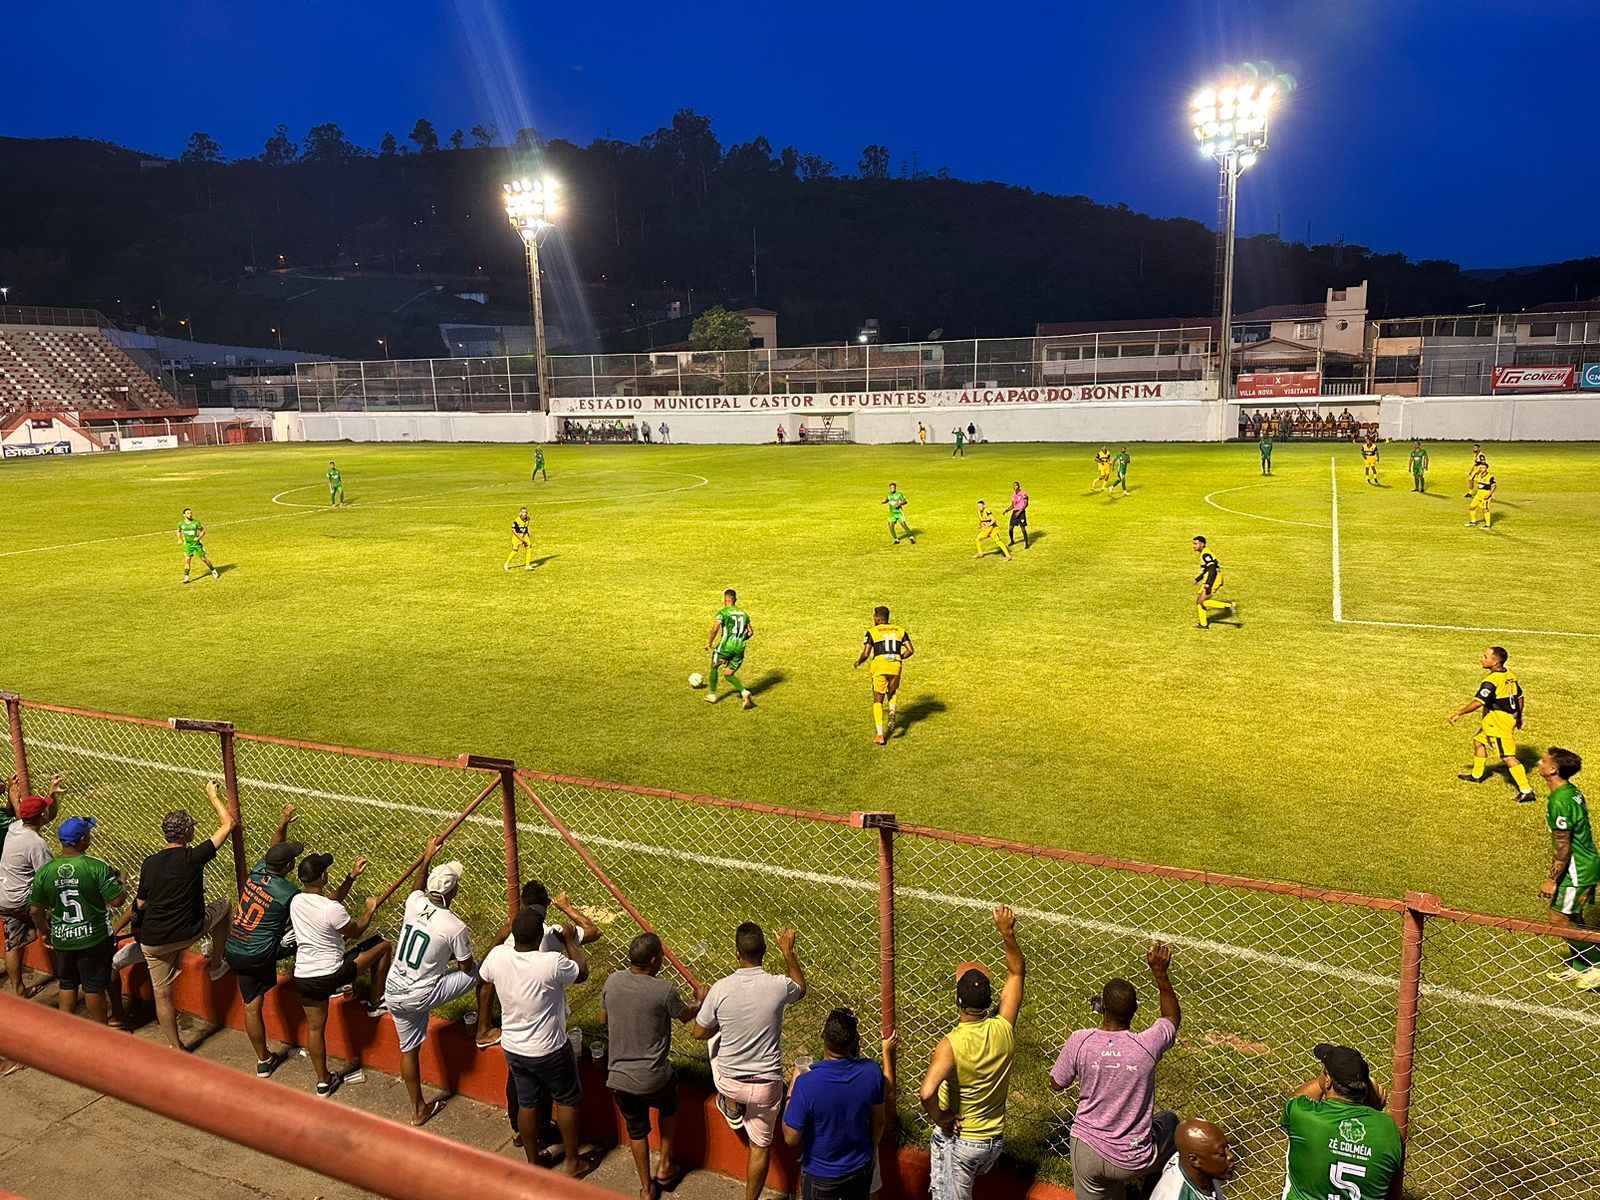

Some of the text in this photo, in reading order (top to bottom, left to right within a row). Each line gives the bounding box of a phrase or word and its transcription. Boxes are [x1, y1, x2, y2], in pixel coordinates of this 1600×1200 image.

[1523, 372, 1565, 381] CONEM
[1047, 388, 1073, 401] DO
[1081, 383, 1162, 401] BONFIM
[1284, 387, 1317, 395] VISITANTE
[579, 392, 927, 410] ESTÁDIO MUNICIPAL CASTOR CIFUENTES
[883, 633, 897, 652] 11
[60, 889, 84, 924] 5
[398, 923, 431, 970] 10
[1328, 1137, 1339, 1150] ZÉ
[1339, 1141, 1372, 1158] COLMÉIA
[1328, 1161, 1367, 1200] 5
